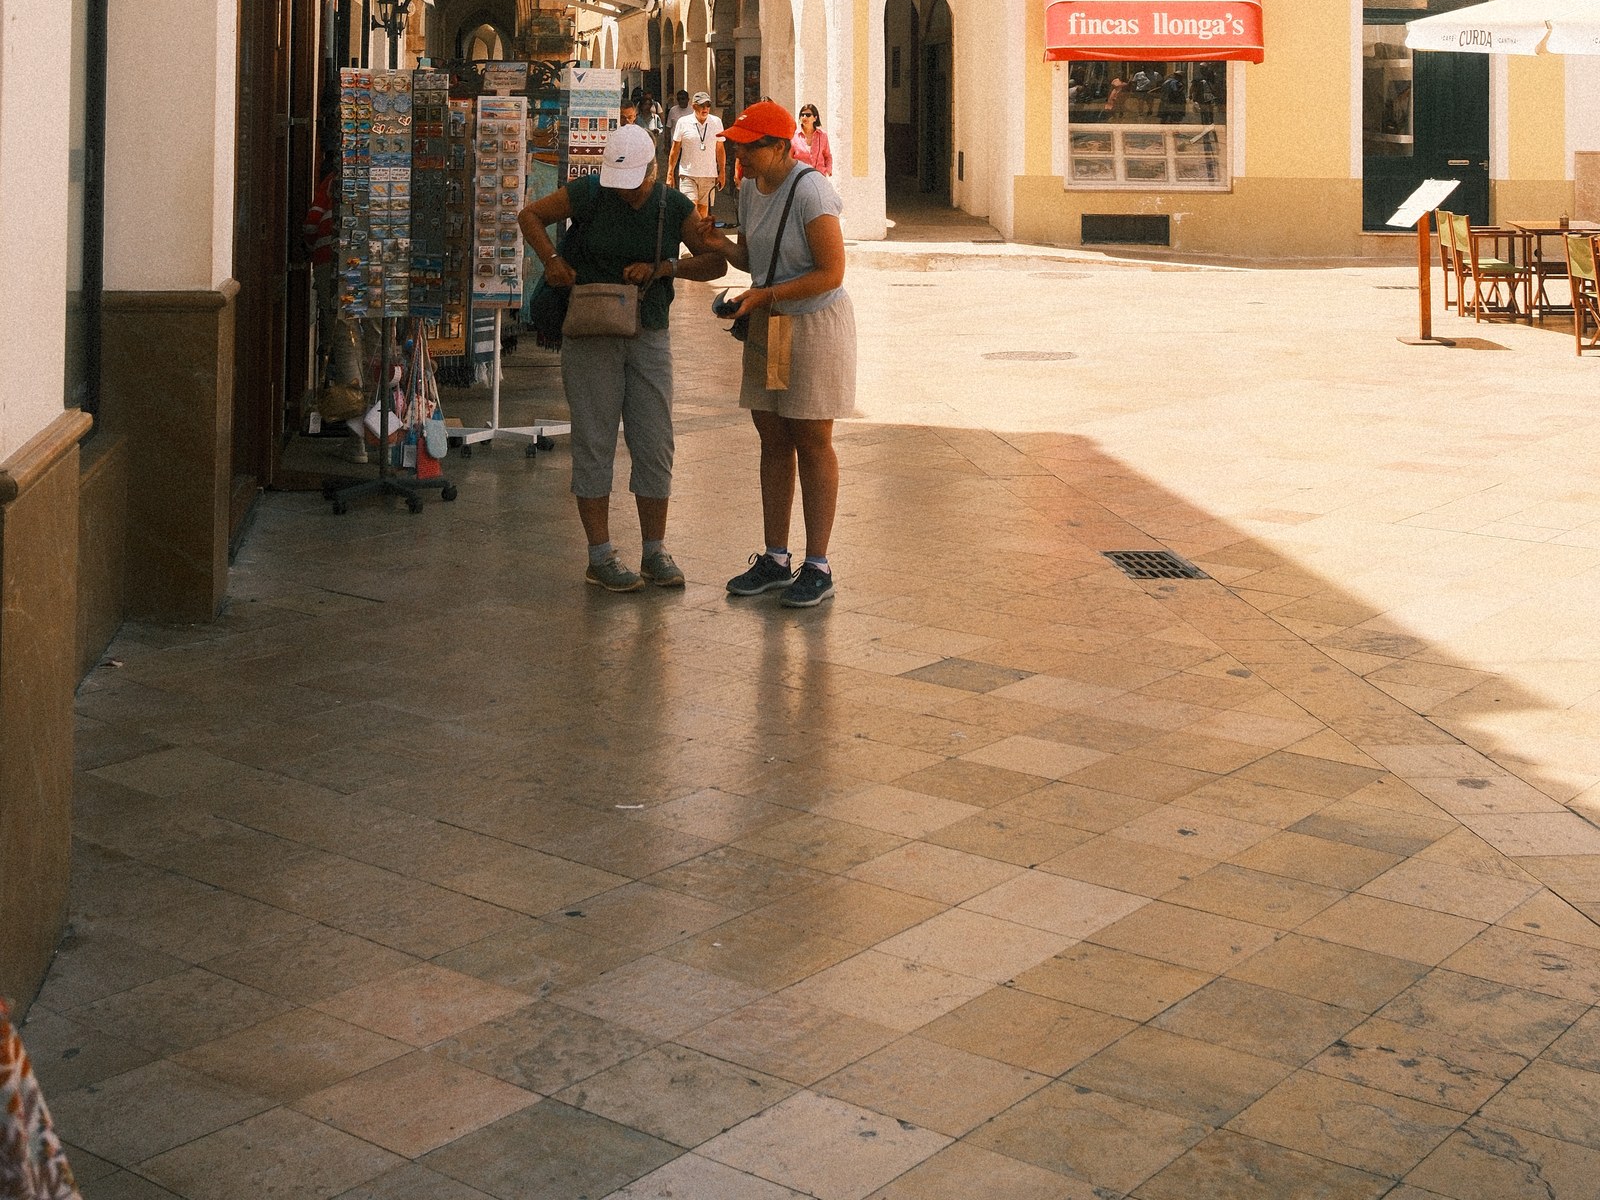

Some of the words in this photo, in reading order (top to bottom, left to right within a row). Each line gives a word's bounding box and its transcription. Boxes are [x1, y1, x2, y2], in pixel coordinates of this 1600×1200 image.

[1068, 12, 1140, 36] fincas
[1152, 12, 1245, 40] llonga's
[1459, 29, 1492, 48] CURDA
